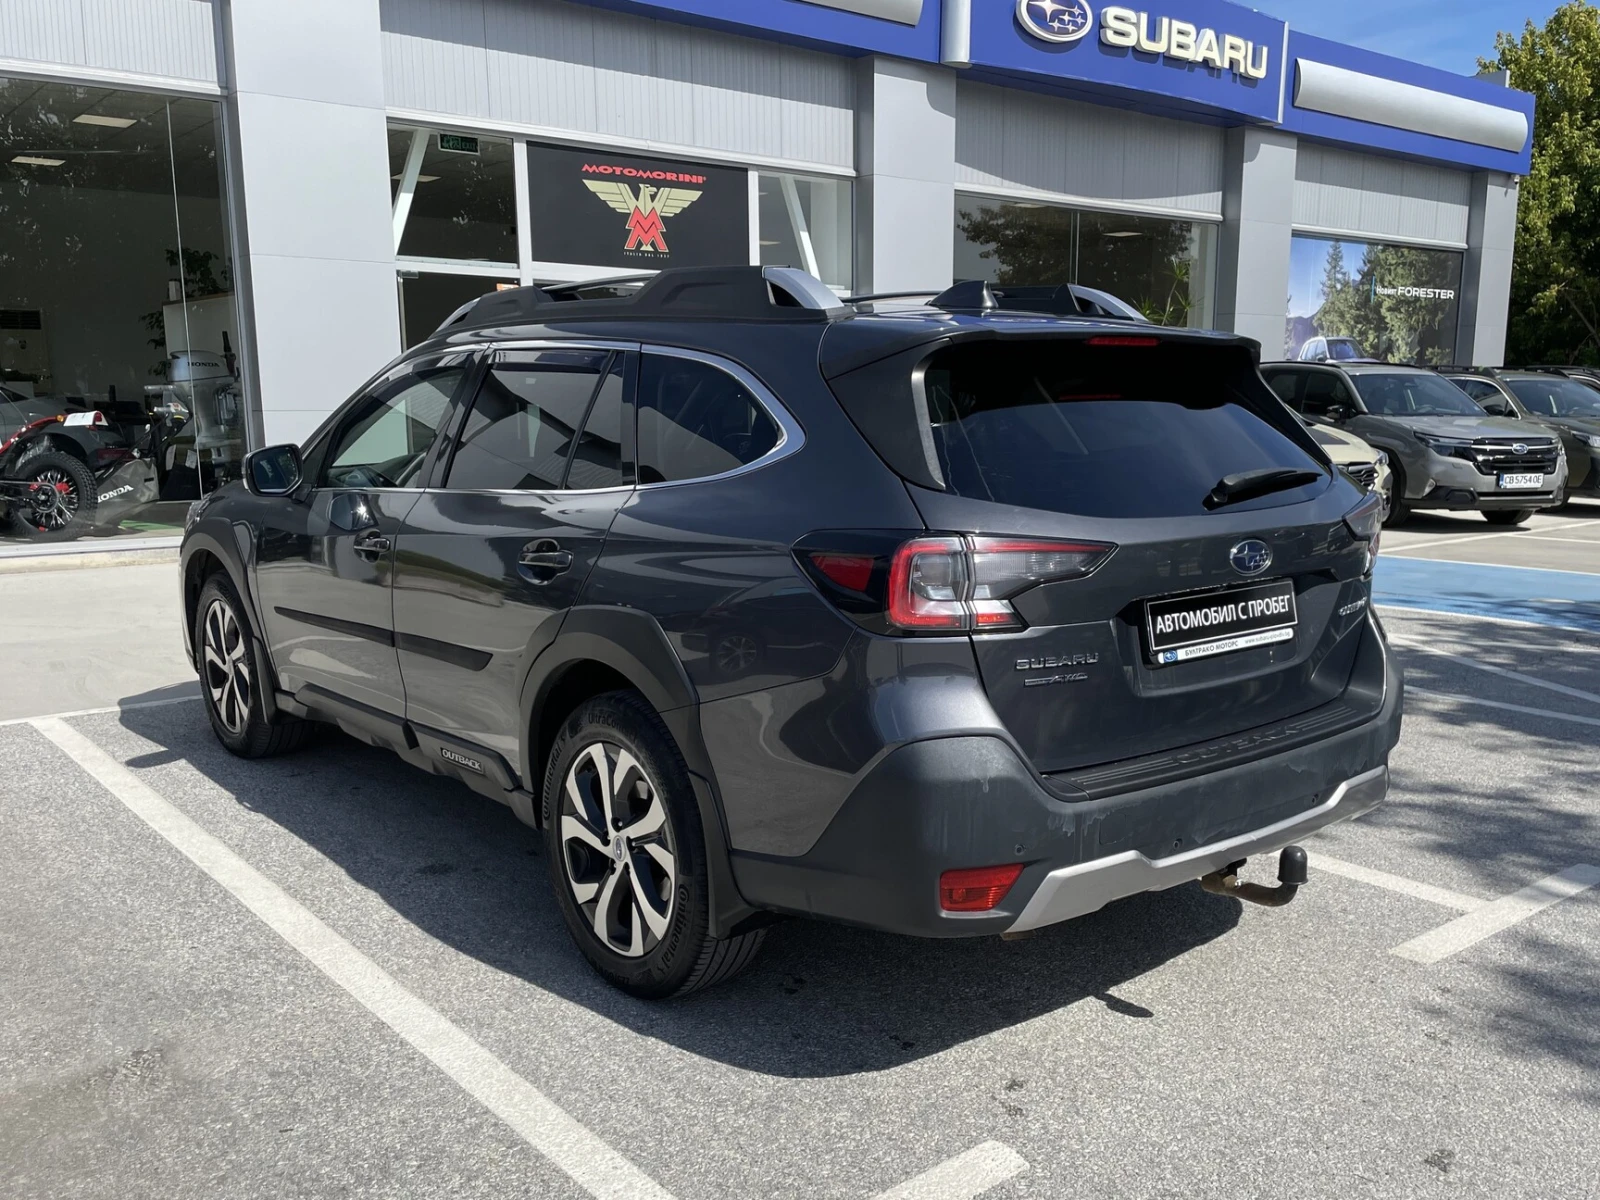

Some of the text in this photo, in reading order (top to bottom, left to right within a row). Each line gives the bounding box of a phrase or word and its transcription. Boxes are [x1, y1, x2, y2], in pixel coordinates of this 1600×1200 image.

[1101, 6, 1269, 79] SUBARU
[581, 163, 704, 184] MOTOMORINI
[1397, 286, 1455, 299] FORESTER
[1156, 594, 1291, 634] АВТОМОБИЛ С ПРОБЕГ
[1215, 640, 1239, 650] МОТОРС
[1016, 652, 1099, 670] SUBARU
[442, 749, 481, 770] OUTBACK
